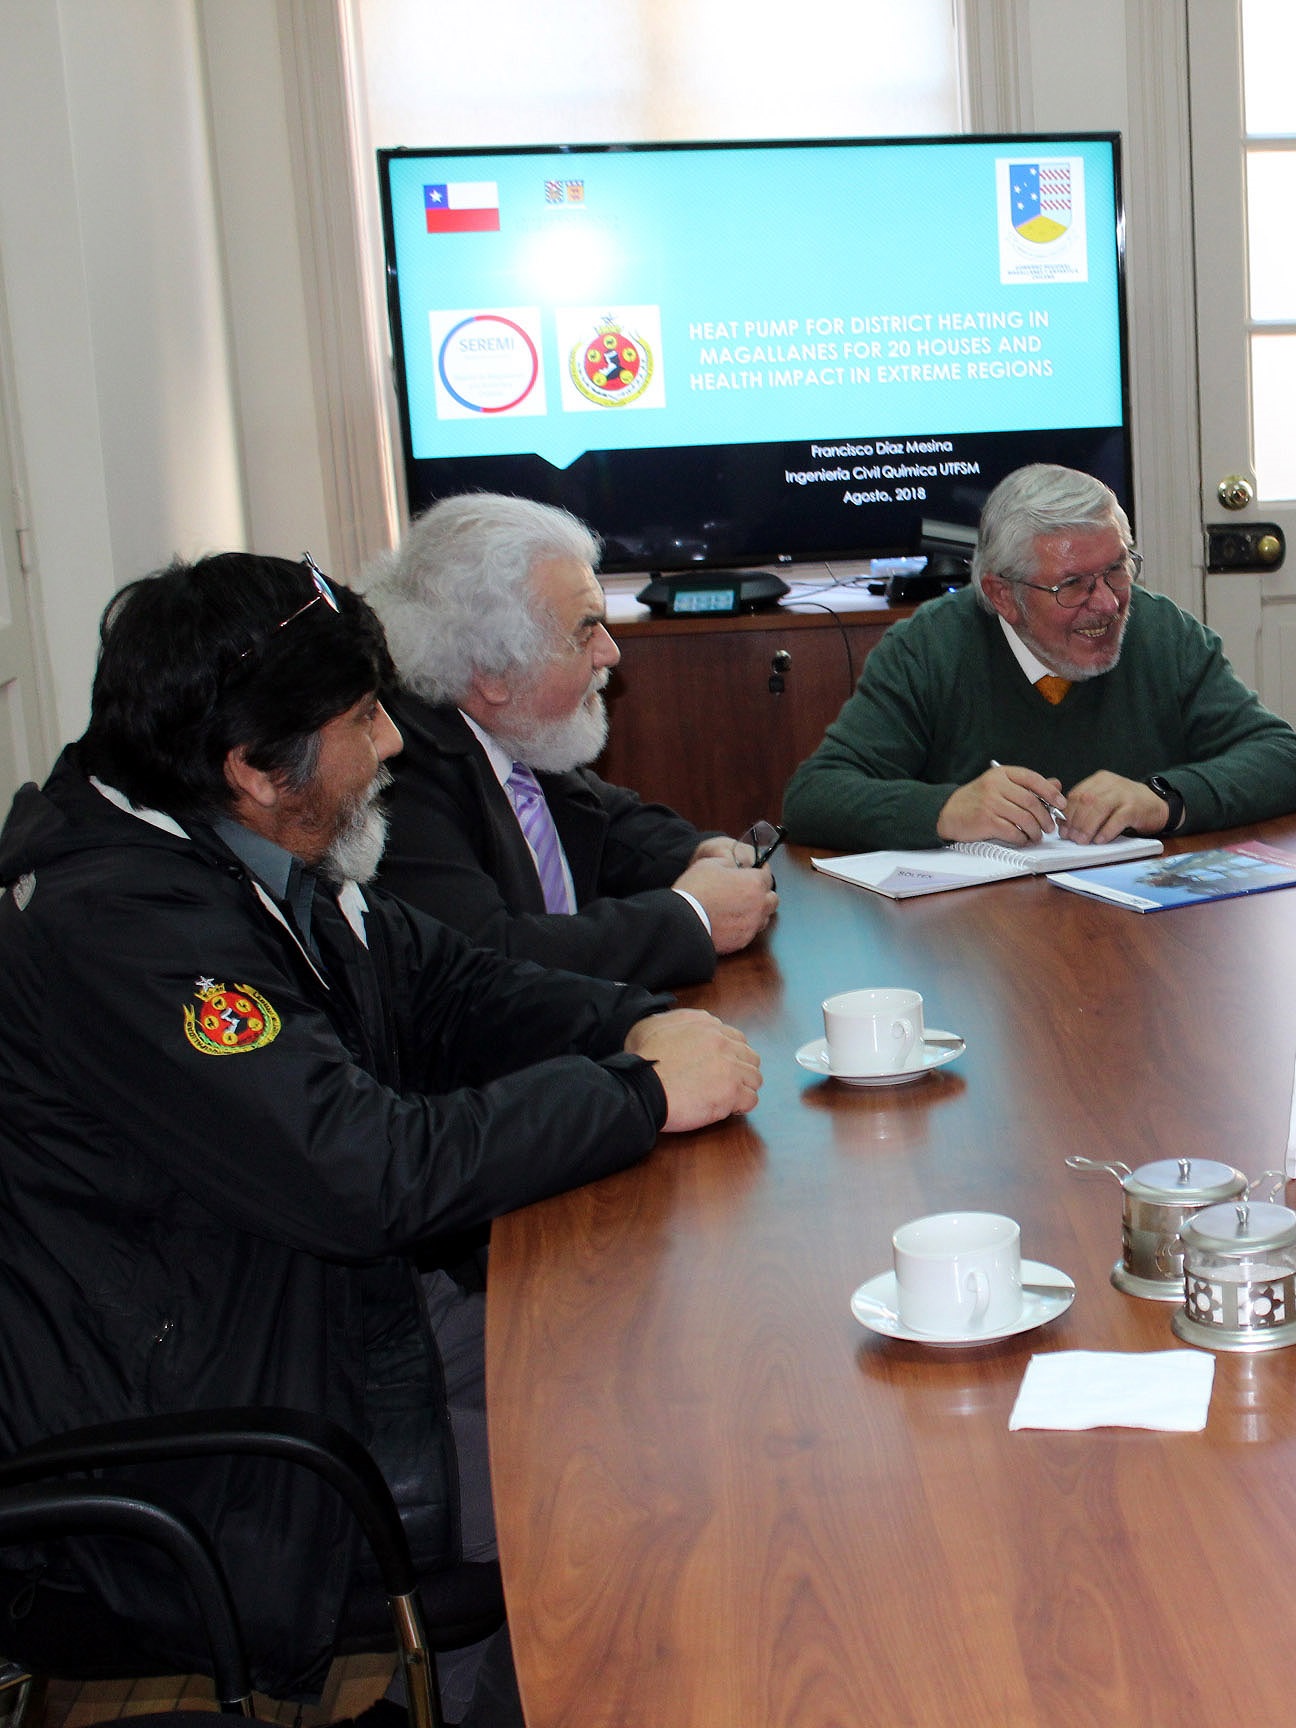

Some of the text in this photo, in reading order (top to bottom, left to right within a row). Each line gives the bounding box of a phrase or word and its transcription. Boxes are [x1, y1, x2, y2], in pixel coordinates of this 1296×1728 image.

[689, 310, 1049, 340] HEAT PUMP FOR DISTRICT HEATING IN
[459, 337, 514, 352] SEREMI
[700, 336, 1042, 365] MAGALLANES FOR 20 HOUSES AND
[689, 360, 1053, 391] HEALTH IMPACT IN EXTREME REGIONS
[811, 443, 874, 458] Francisco
[906, 439, 953, 454] Mesina
[853, 466, 880, 480] Civil
[939, 462, 980, 475] UTFSM
[895, 486, 926, 501] 2018
